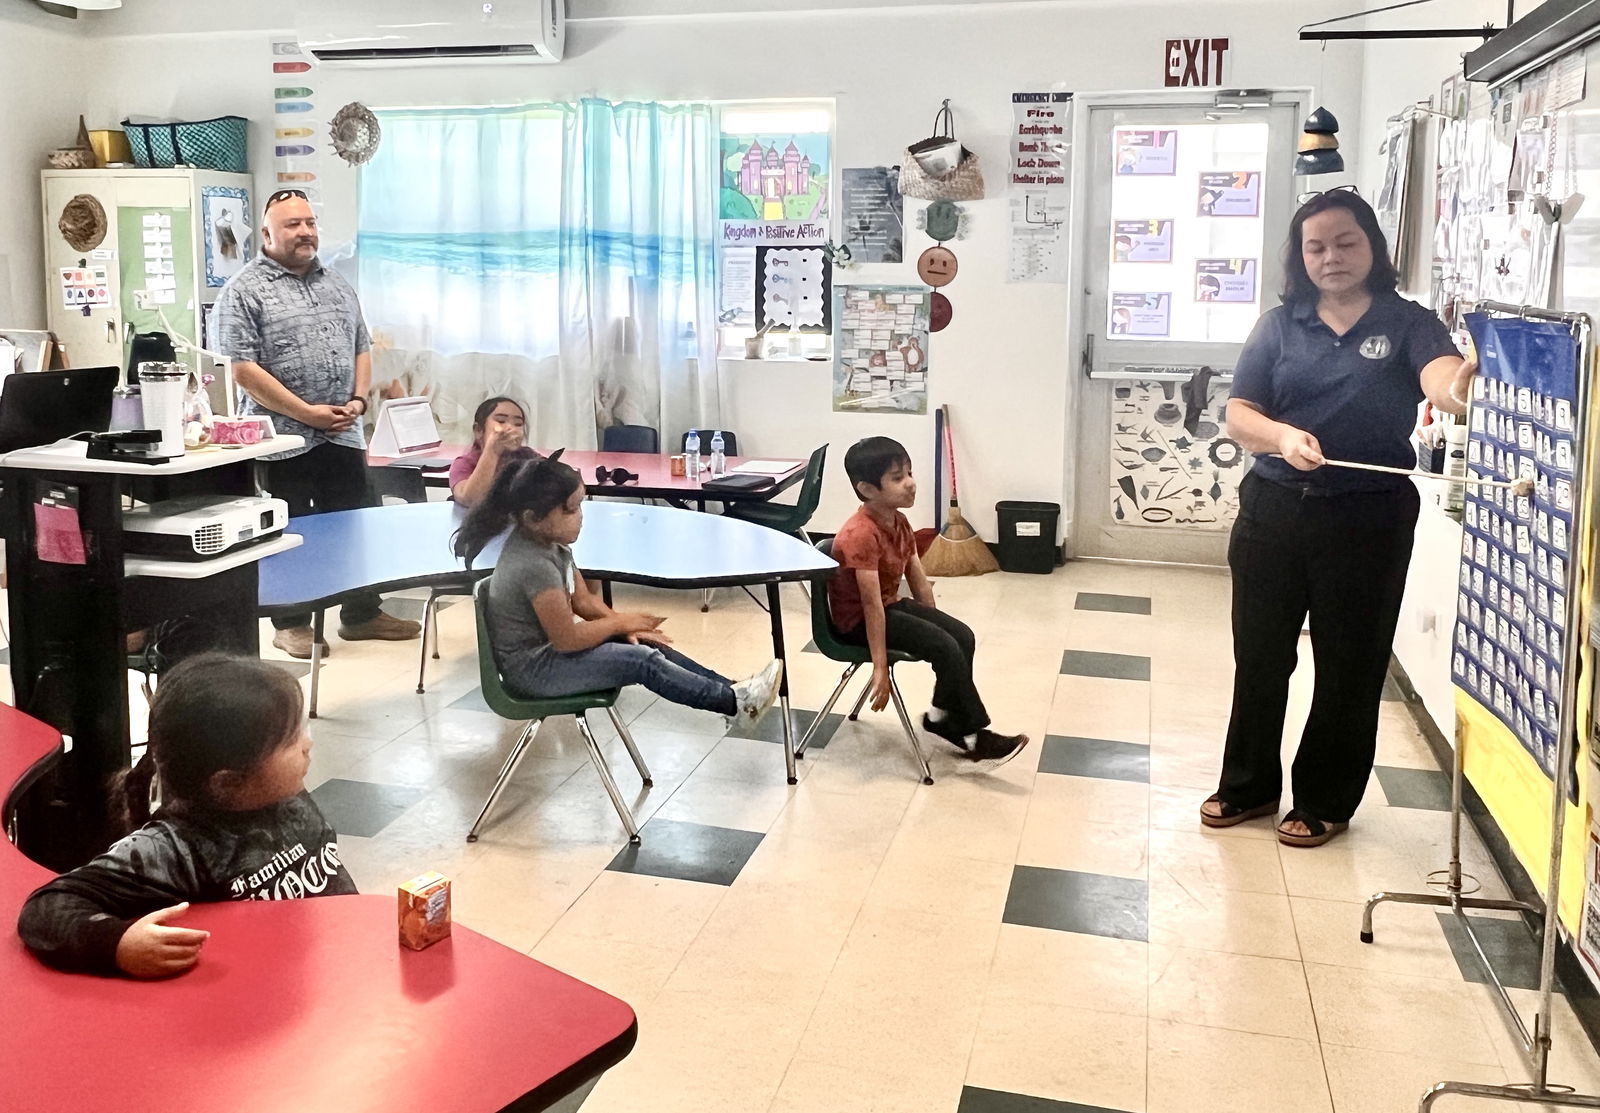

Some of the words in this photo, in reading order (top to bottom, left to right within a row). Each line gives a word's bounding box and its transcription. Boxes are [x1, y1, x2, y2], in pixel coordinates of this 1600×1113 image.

[1164, 38, 1229, 87] EXIT
[1232, 171, 1248, 190] 2
[723, 222, 757, 240] Kingdom
[1149, 220, 1159, 236] 3
[1145, 293, 1158, 310] 5
[231, 843, 307, 898] Familian
